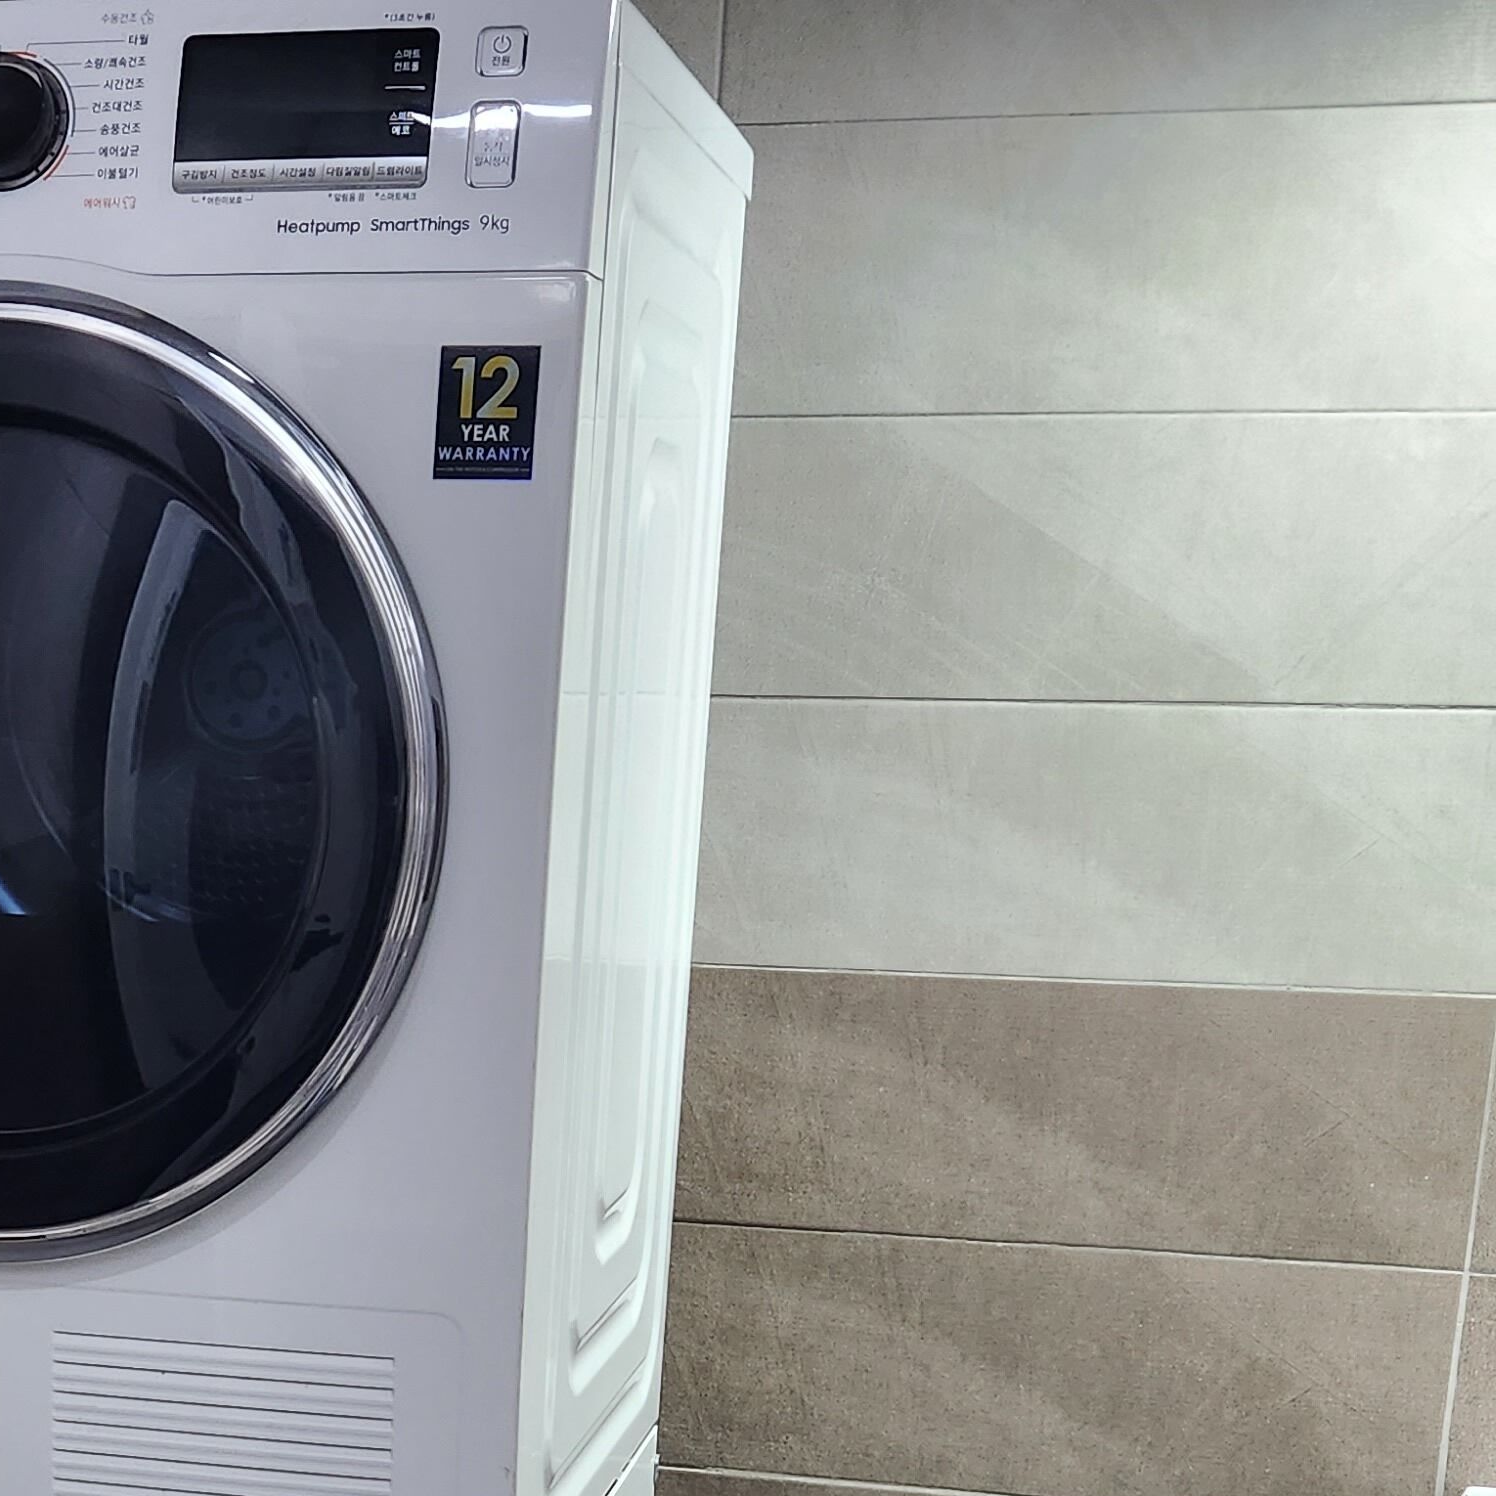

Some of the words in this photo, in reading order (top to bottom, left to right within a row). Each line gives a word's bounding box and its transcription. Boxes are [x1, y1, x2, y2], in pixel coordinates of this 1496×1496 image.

[394, 49, 421, 59] 스마트
[492, 56, 511, 67] 전원
[103, 78, 144, 90] 시간건조
[92, 100, 144, 114] 건조대건조
[100, 122, 141, 135] 송풍건조
[98, 144, 140, 157] 에어살균
[97, 166, 139, 179] 이불털기
[276, 219, 361, 236] Heatpump
[370, 216, 470, 235] SmartThings
[479, 214, 510, 234] 9kg
[451, 355, 520, 419] 12
[461, 424, 510, 442] YEAR
[438, 446, 531, 461] WARRANTY
